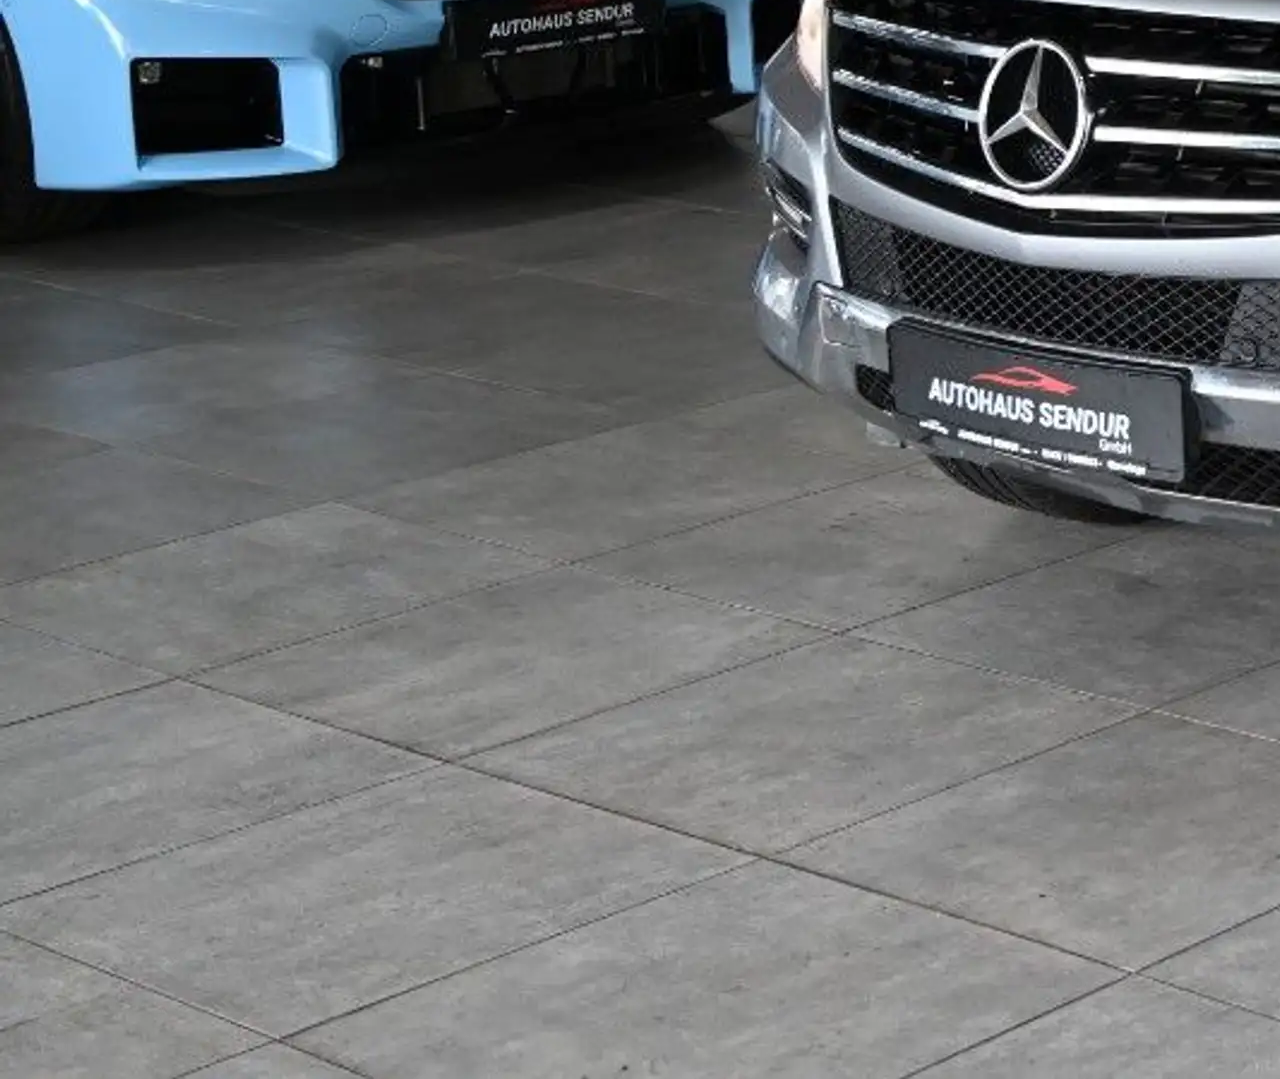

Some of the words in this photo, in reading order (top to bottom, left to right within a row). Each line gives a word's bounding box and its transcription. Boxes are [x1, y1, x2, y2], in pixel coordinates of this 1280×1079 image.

[489, 10, 574, 39] AUTOHAUS
[577, 1, 635, 25] SENDUR
[928, 377, 1036, 424] AUTOHAUS
[1039, 401, 1130, 440] SENDUR
[1099, 437, 1132, 456] GmbH
